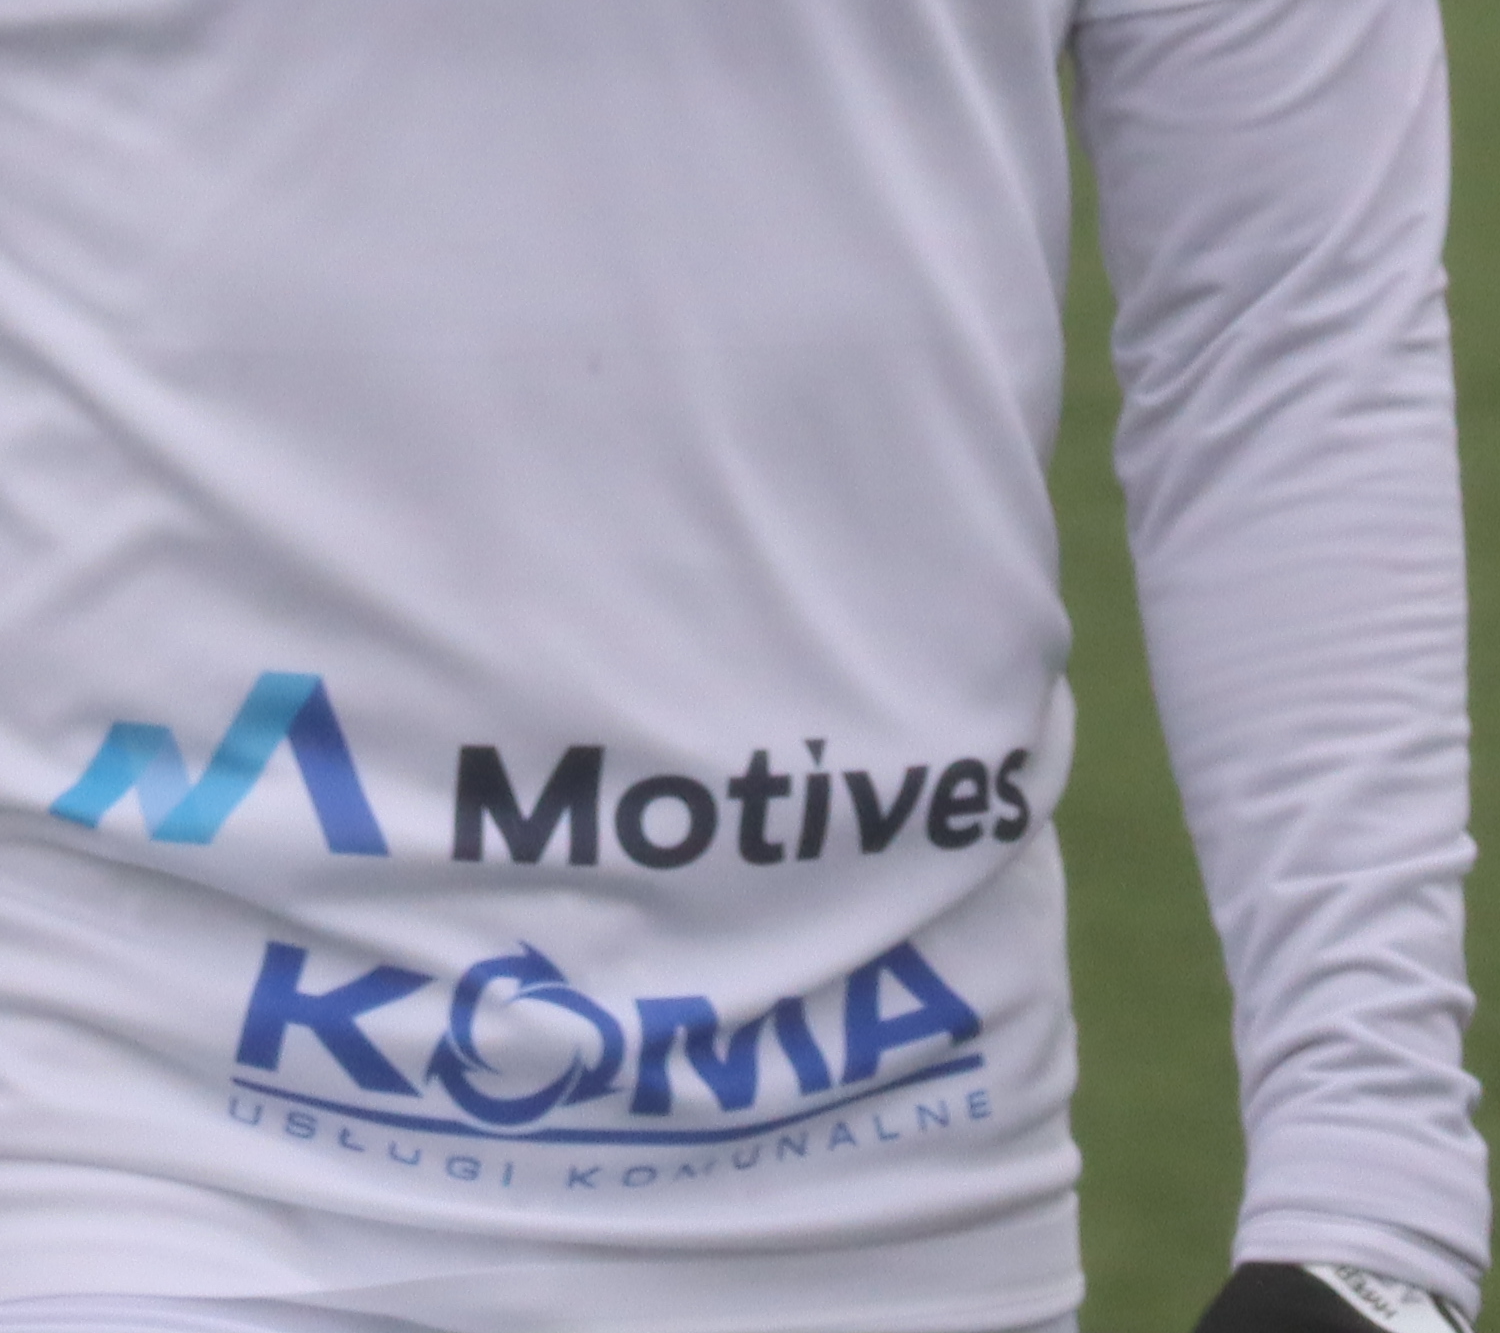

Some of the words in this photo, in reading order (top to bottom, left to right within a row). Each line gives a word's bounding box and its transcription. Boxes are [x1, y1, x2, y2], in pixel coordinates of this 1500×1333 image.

[451, 738, 1032, 870] Motives
[234, 940, 984, 1128] KOMA
[228, 1096, 516, 1188] USŁUGI
[566, 1090, 996, 1190] KOMUNALNE
